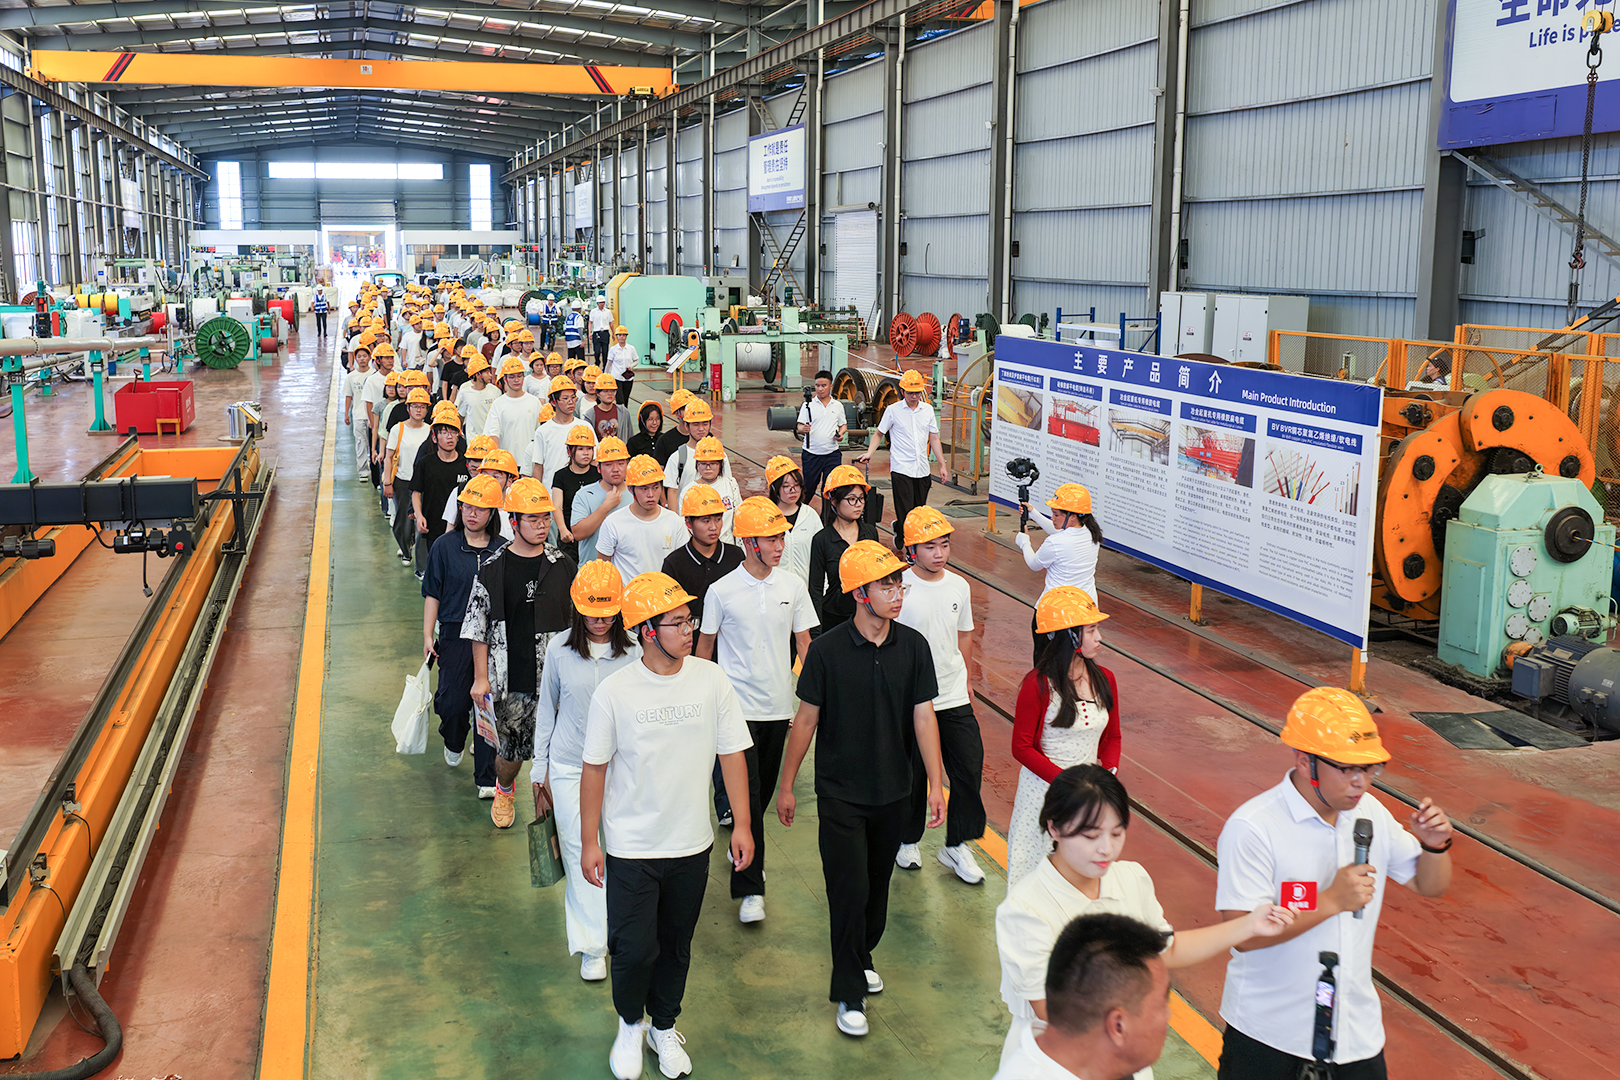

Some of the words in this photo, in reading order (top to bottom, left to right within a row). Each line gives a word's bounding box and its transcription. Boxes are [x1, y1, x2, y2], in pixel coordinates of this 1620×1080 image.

[1529, 28, 1558, 48] Life
[1562, 24, 1575, 42] is
[1073, 350, 1223, 394] 主要产品简介
[1241, 389, 1260, 402] Main
[1260, 392, 1289, 407] Product
[1289, 397, 1337, 414] Introduction
[1271, 422, 1280, 431] BV
[635, 702, 703, 724] CENTURY
